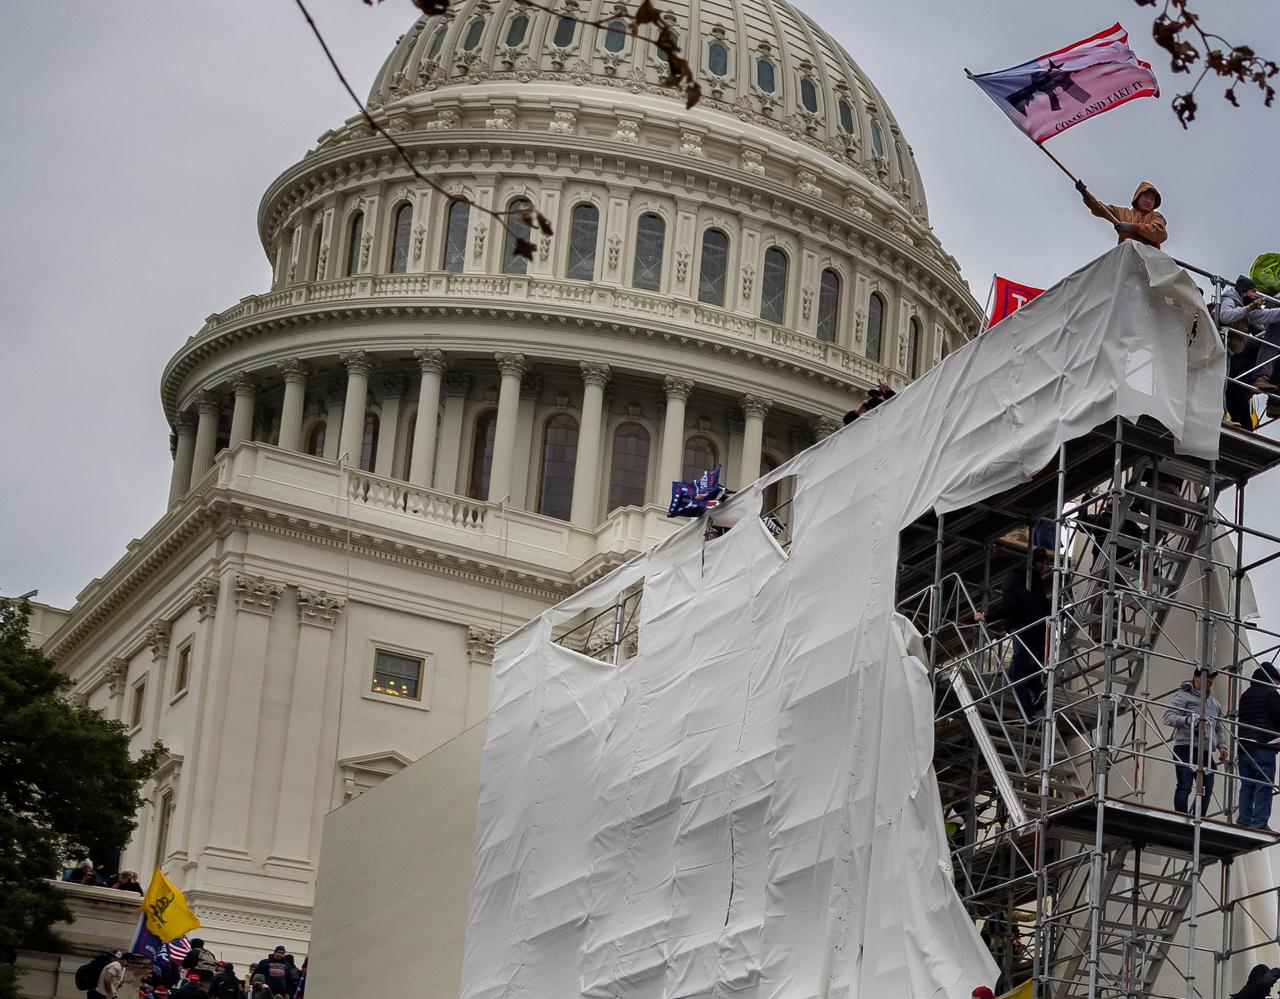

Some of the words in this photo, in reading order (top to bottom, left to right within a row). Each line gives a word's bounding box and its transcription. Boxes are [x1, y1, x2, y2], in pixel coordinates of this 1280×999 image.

[1055, 112, 1083, 131] COME
[1085, 101, 1106, 116] AND
[1106, 87, 1132, 104] TAKE
[1131, 80, 1143, 91] IT
